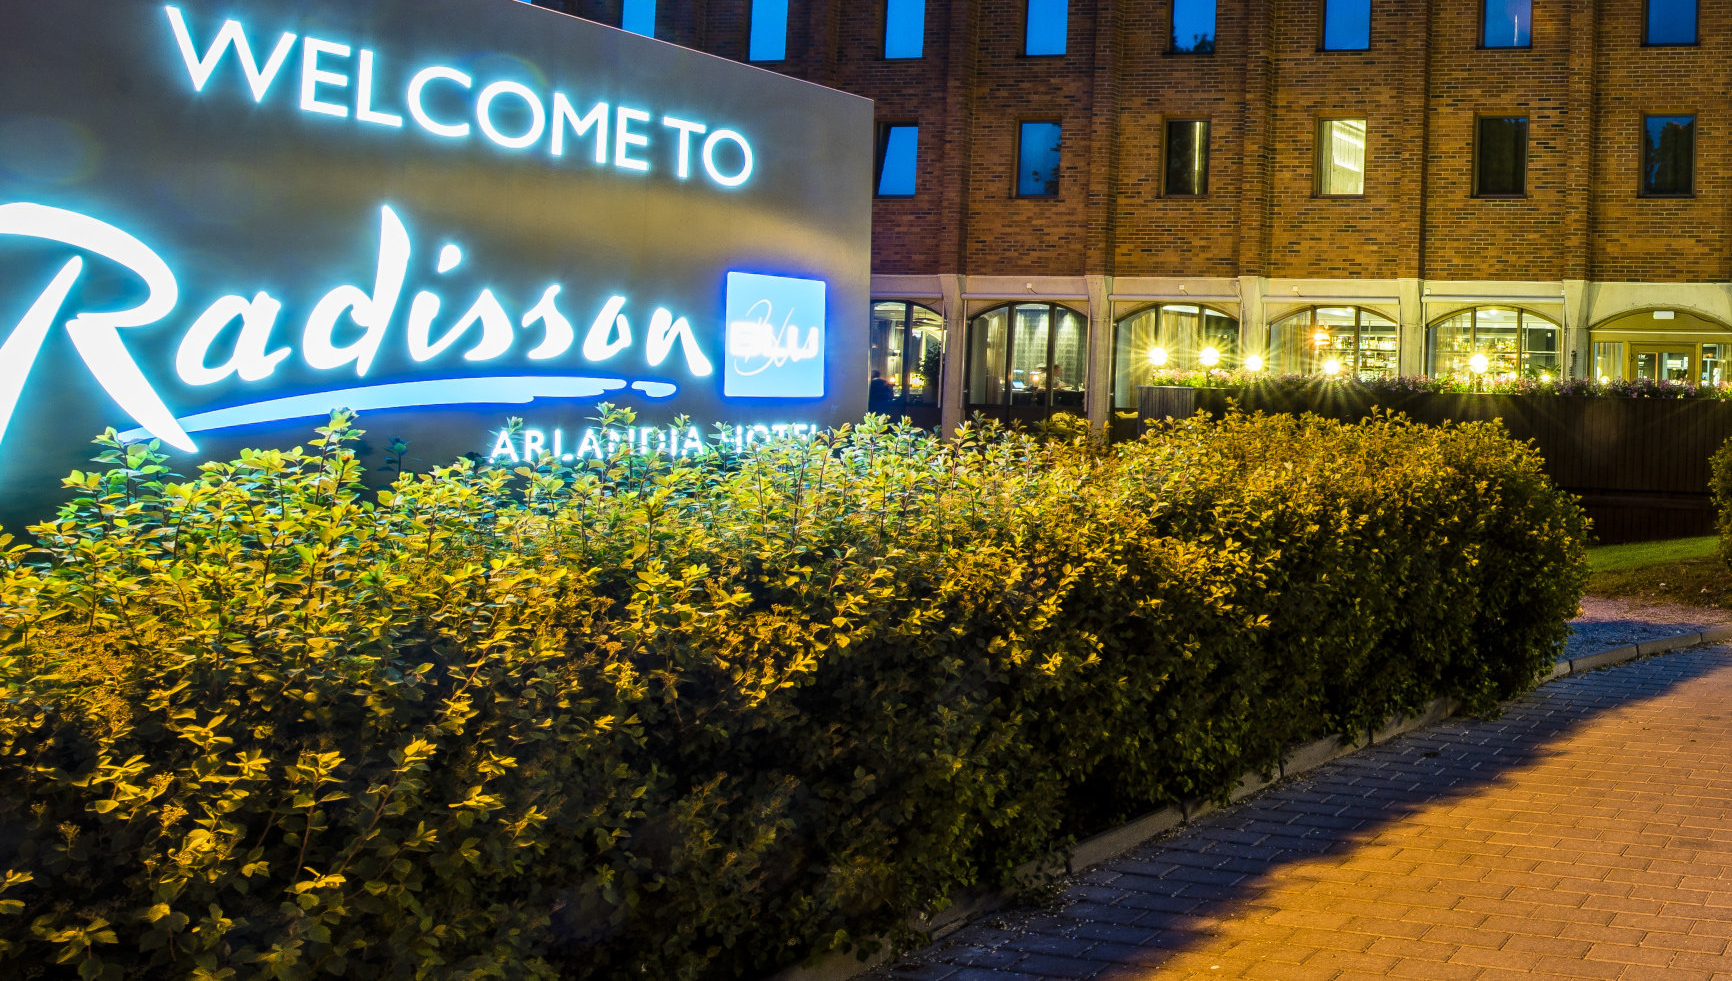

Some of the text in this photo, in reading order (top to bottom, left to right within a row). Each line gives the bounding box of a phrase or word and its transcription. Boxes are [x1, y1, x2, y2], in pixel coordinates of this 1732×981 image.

[165, 5, 754, 188] WELCOME TO
[0, 202, 714, 453] Radisson
